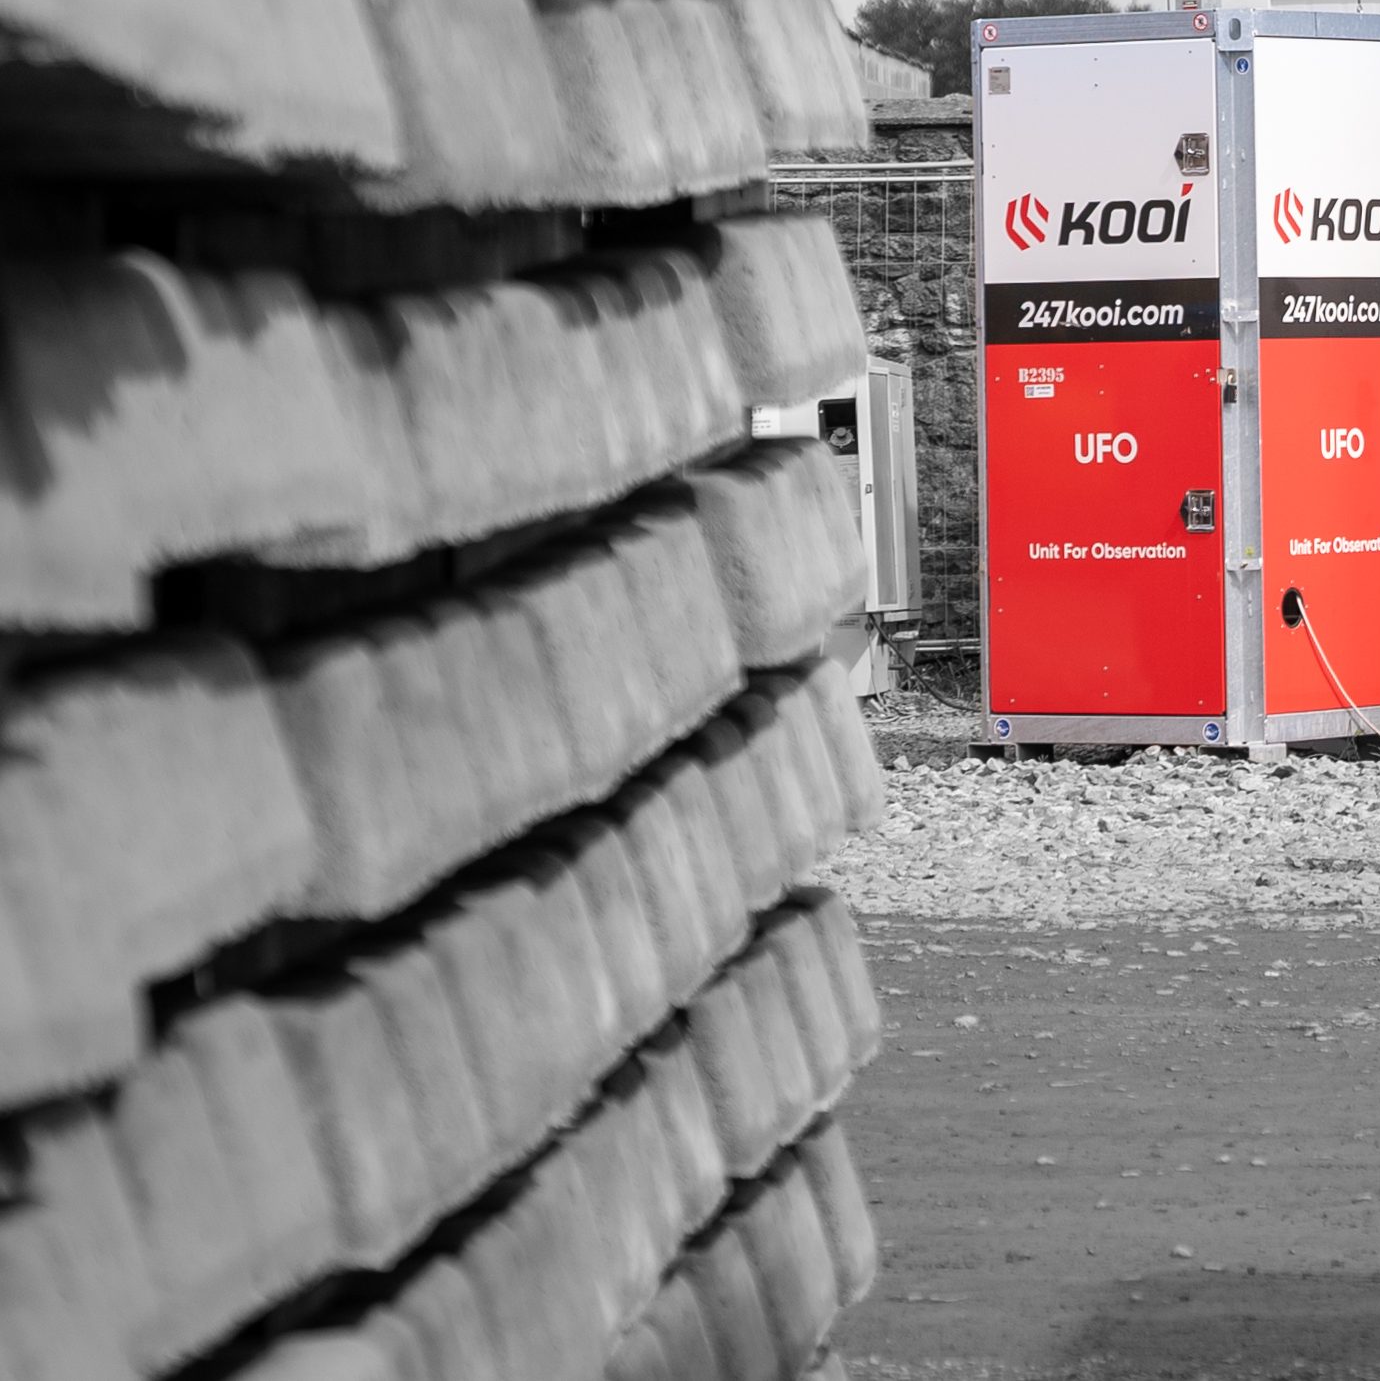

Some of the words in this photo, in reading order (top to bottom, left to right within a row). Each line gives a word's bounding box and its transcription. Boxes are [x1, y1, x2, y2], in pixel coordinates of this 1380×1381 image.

[1018, 298, 1185, 328] 247kooi.com
[1018, 367, 1065, 383] B2395
[1074, 432, 1138, 465] UFO
[1320, 427, 1365, 460] UFO
[1029, 542, 1060, 559] Unit
[1063, 542, 1088, 559] For
[1091, 542, 1187, 559] Observation
[1289, 538, 1312, 556] Unit
[1313, 537, 1331, 555] For
